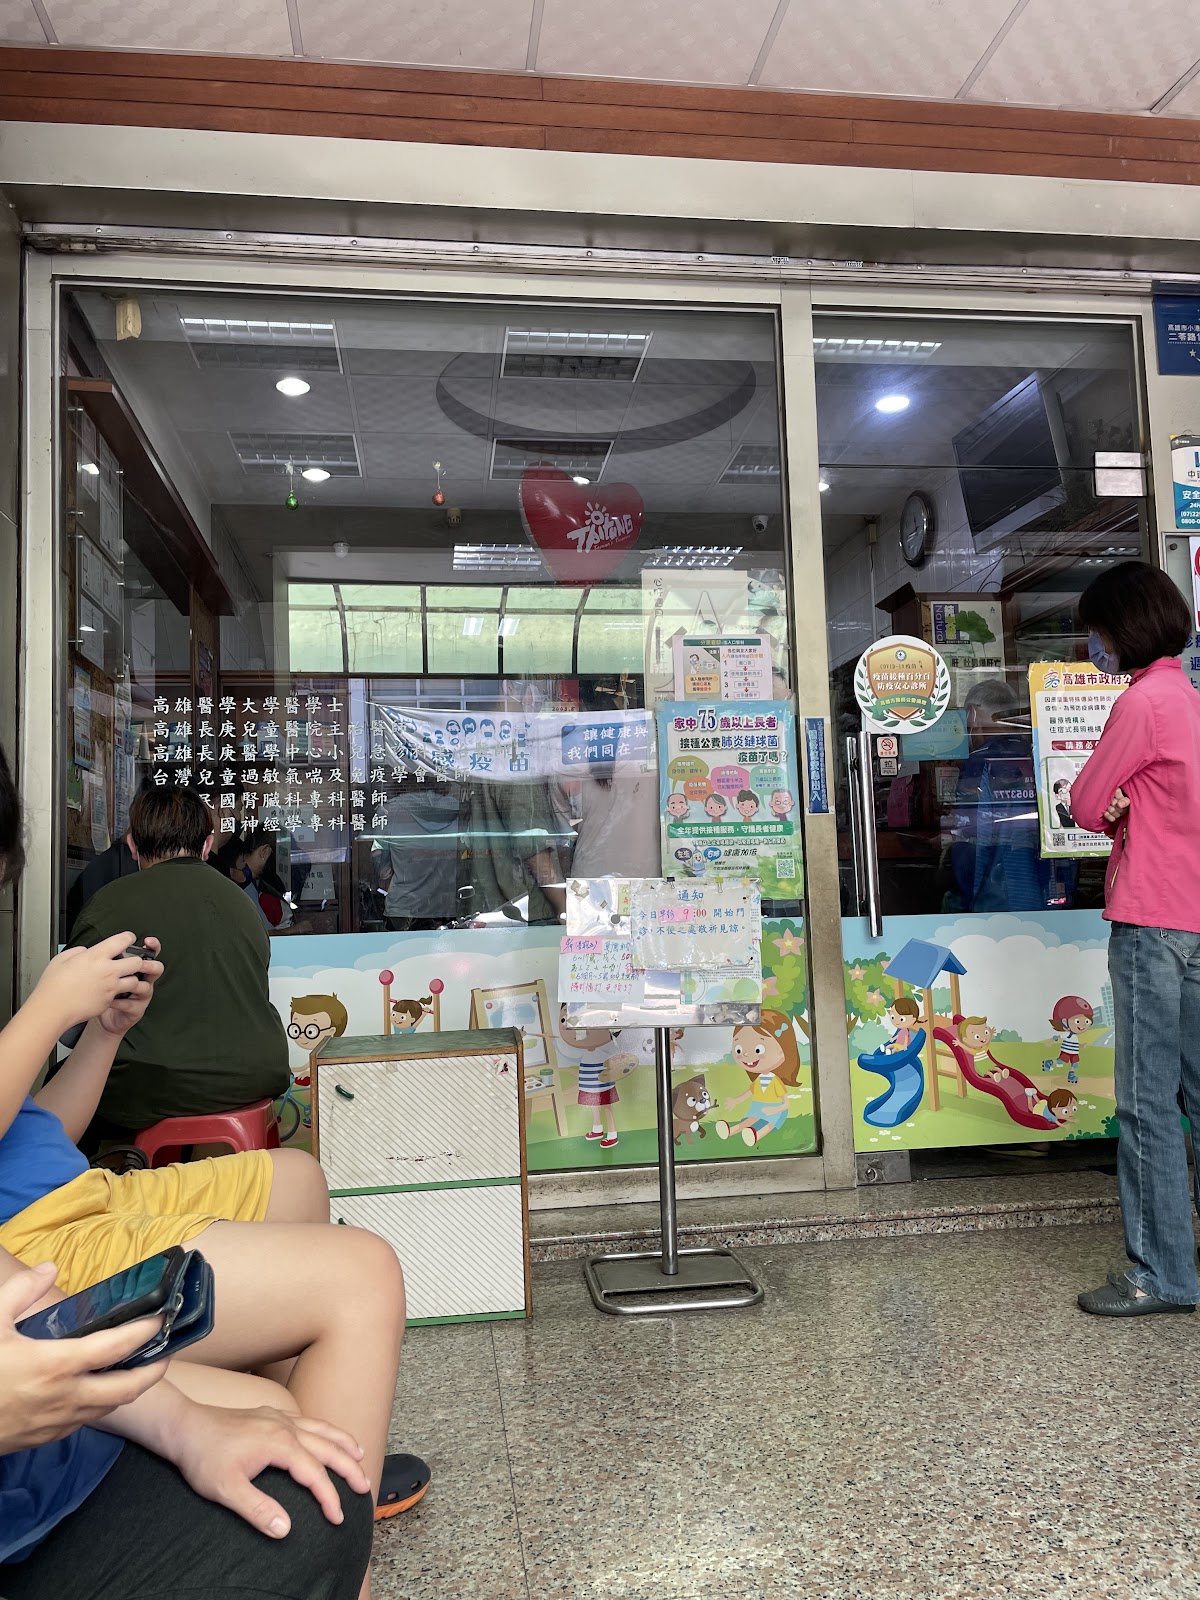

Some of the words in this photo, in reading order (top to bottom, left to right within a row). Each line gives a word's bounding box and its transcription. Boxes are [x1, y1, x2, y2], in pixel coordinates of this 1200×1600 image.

[872, 671, 931, 681] 疫苗接種百分百
[877, 681, 927, 691] 防疫安心診所
[152, 695, 345, 715] 高雄醫學大學醫學士
[152, 719, 408, 739] 高雄長庚兒童醫院主治醫師
[582, 725, 649, 742] 讓健康與
[679, 734, 779, 749] 接種公費肺炎鏈球菌
[152, 764, 471, 788] 台灣兒童過敏氣喘及免疫學會醫師
[677, 889, 704, 902] 通知
[713, 908, 745, 918] 開始門
